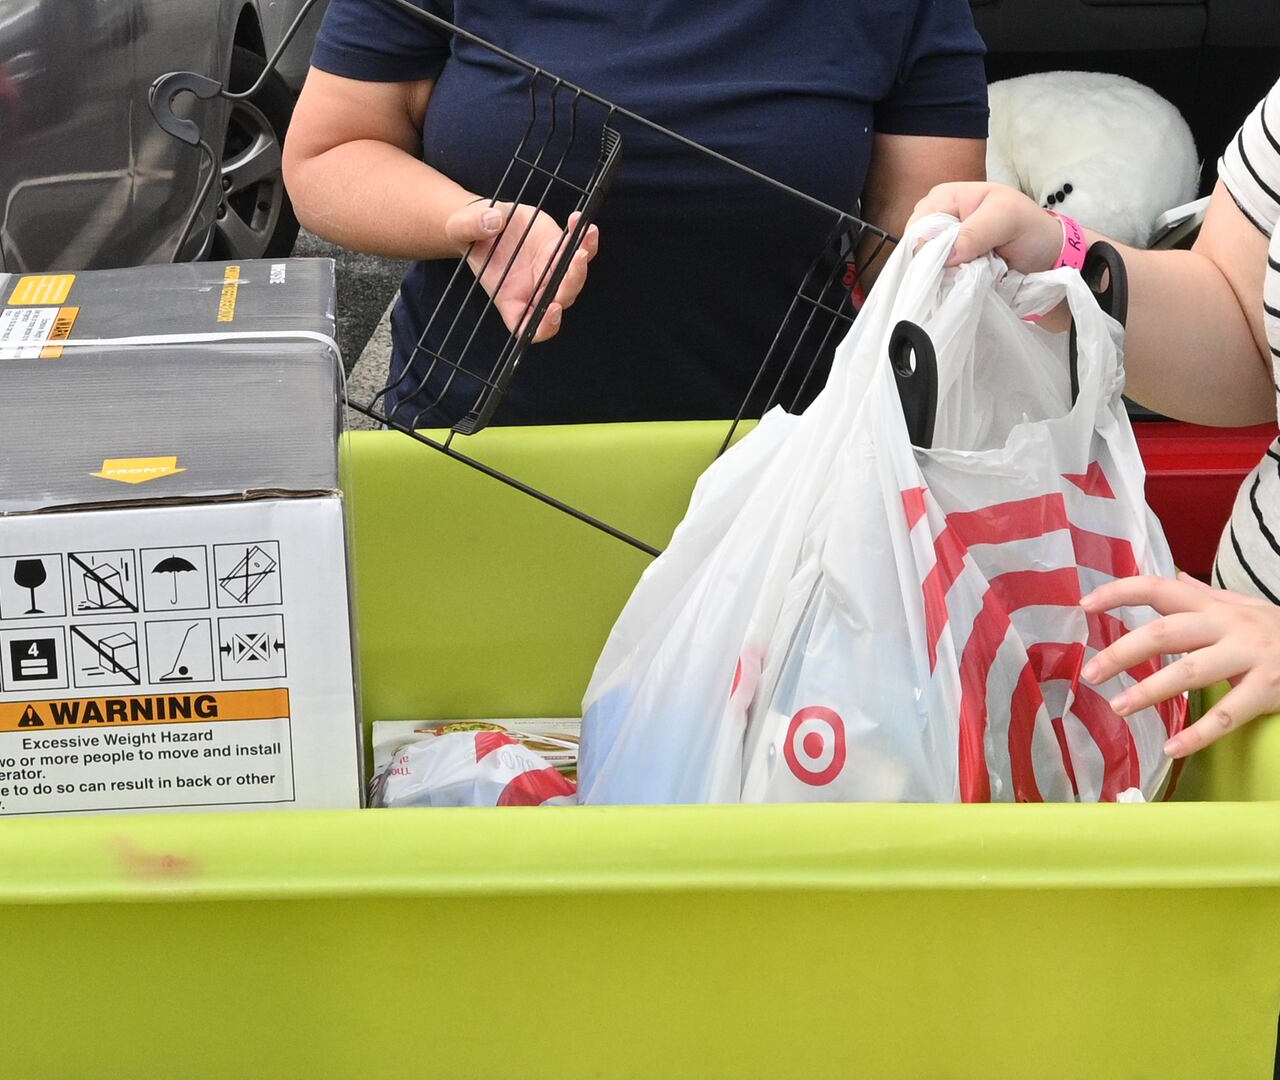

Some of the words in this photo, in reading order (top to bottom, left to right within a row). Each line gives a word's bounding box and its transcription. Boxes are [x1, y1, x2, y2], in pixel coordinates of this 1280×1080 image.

[106, 466, 170, 475] FRONT
[27, 642, 40, 657] 4
[49, 695, 219, 726] WARNING
[22, 735, 100, 750] Excessive
[103, 732, 157, 747] Weight
[160, 729, 213, 743] Hazard
[19, 757, 36, 767] or
[40, 754, 79, 766] more
[83, 749, 135, 767] people
[138, 749, 154, 761] to
[157, 748, 199, 760] move
[203, 744, 231, 758] and
[235, 742, 281, 756] install
[13, 784, 29, 796] to
[32, 782, 52, 795] do
[56, 783, 75, 794] so
[79, 782, 106, 793] can
[110, 777, 154, 791] result
[158, 776, 172, 789] in
[176, 775, 212, 788] back
[216, 776, 232, 786] or
[236, 772, 276, 786] other
